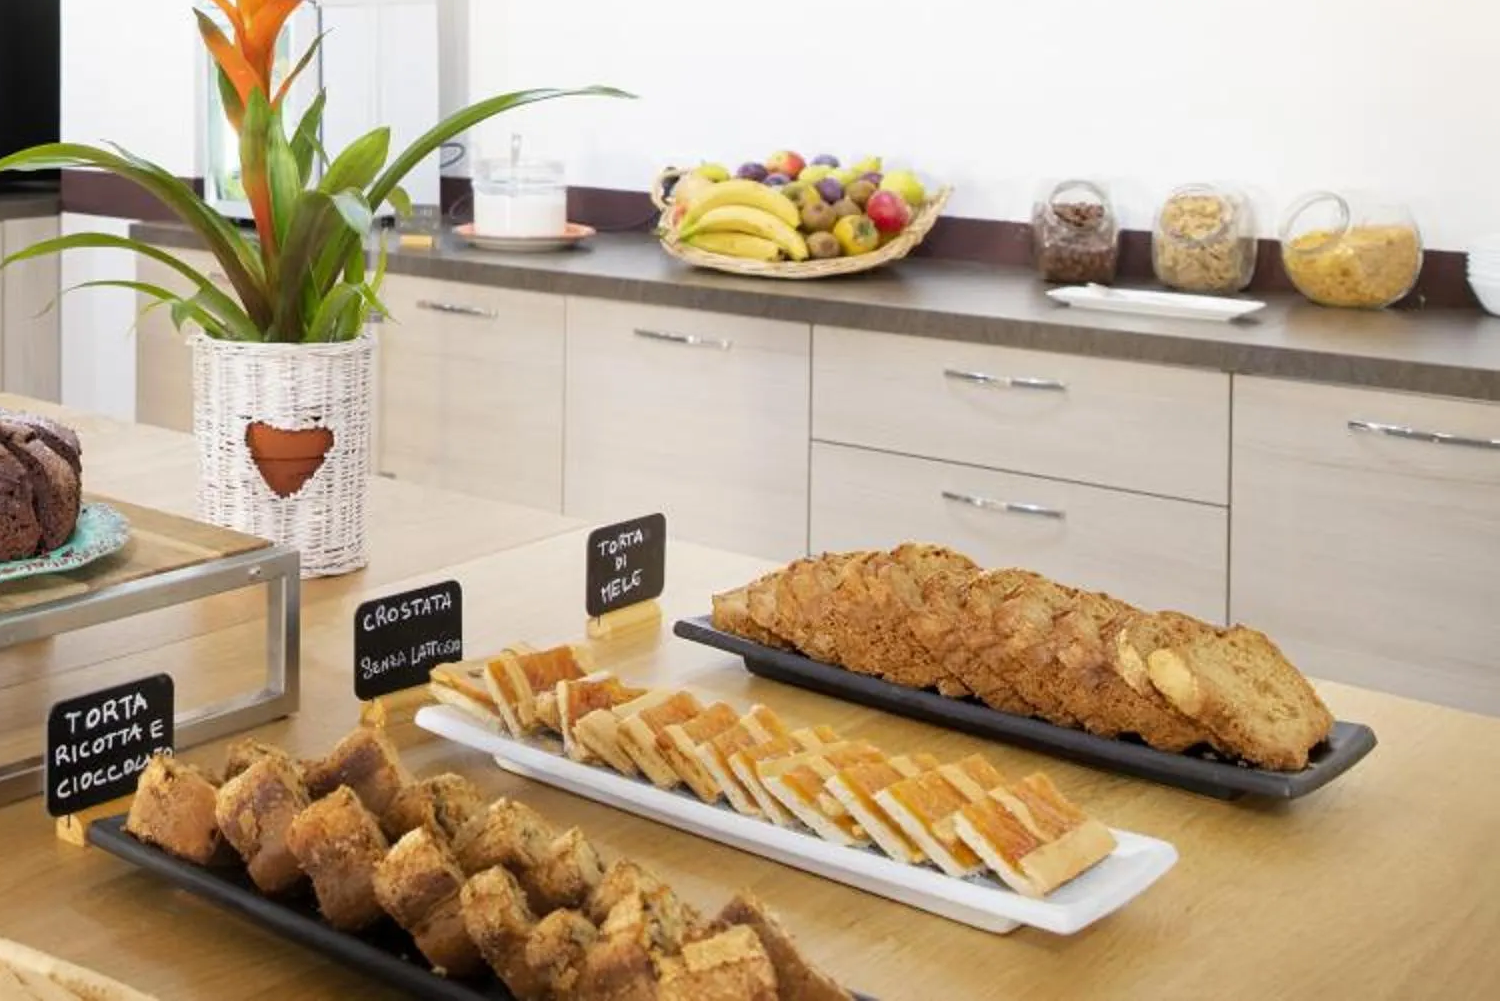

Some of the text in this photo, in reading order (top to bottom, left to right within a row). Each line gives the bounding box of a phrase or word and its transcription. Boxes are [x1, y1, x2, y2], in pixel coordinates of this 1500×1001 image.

[597, 528, 643, 557] TORTA
[363, 591, 452, 631] CROSTATA
[64, 692, 148, 734] TORTA
[55, 718, 164, 766] RICOTTA E
